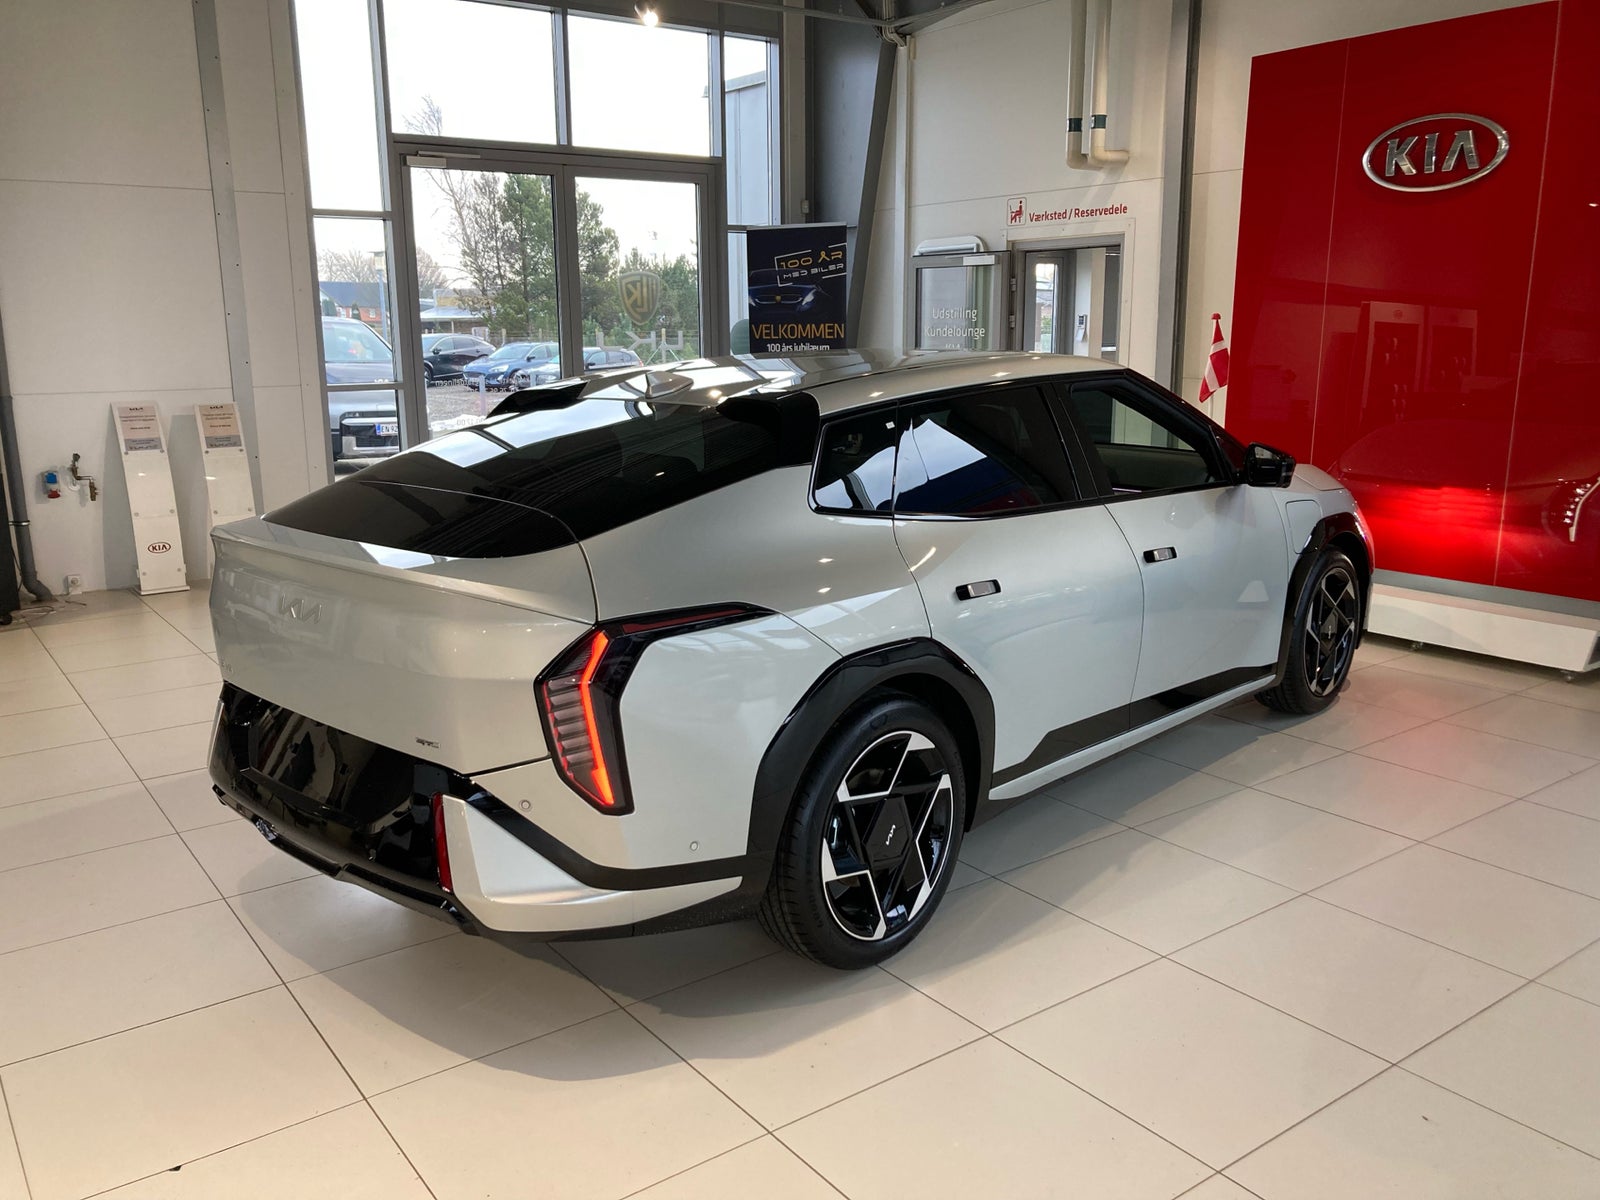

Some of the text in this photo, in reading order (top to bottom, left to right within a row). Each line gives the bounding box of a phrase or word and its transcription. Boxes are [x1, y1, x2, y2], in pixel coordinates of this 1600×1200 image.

[1385, 130, 1480, 177] KIA
[1029, 204, 1128, 222] Værksted / Reservedele
[780, 257, 813, 269] 100
[932, 306, 977, 321] Udstilling
[752, 323, 845, 339] VELKOMMEN
[924, 325, 985, 340] Kundelounge
[766, 343, 781, 352] 100
[151, 544, 168, 552] KIA
